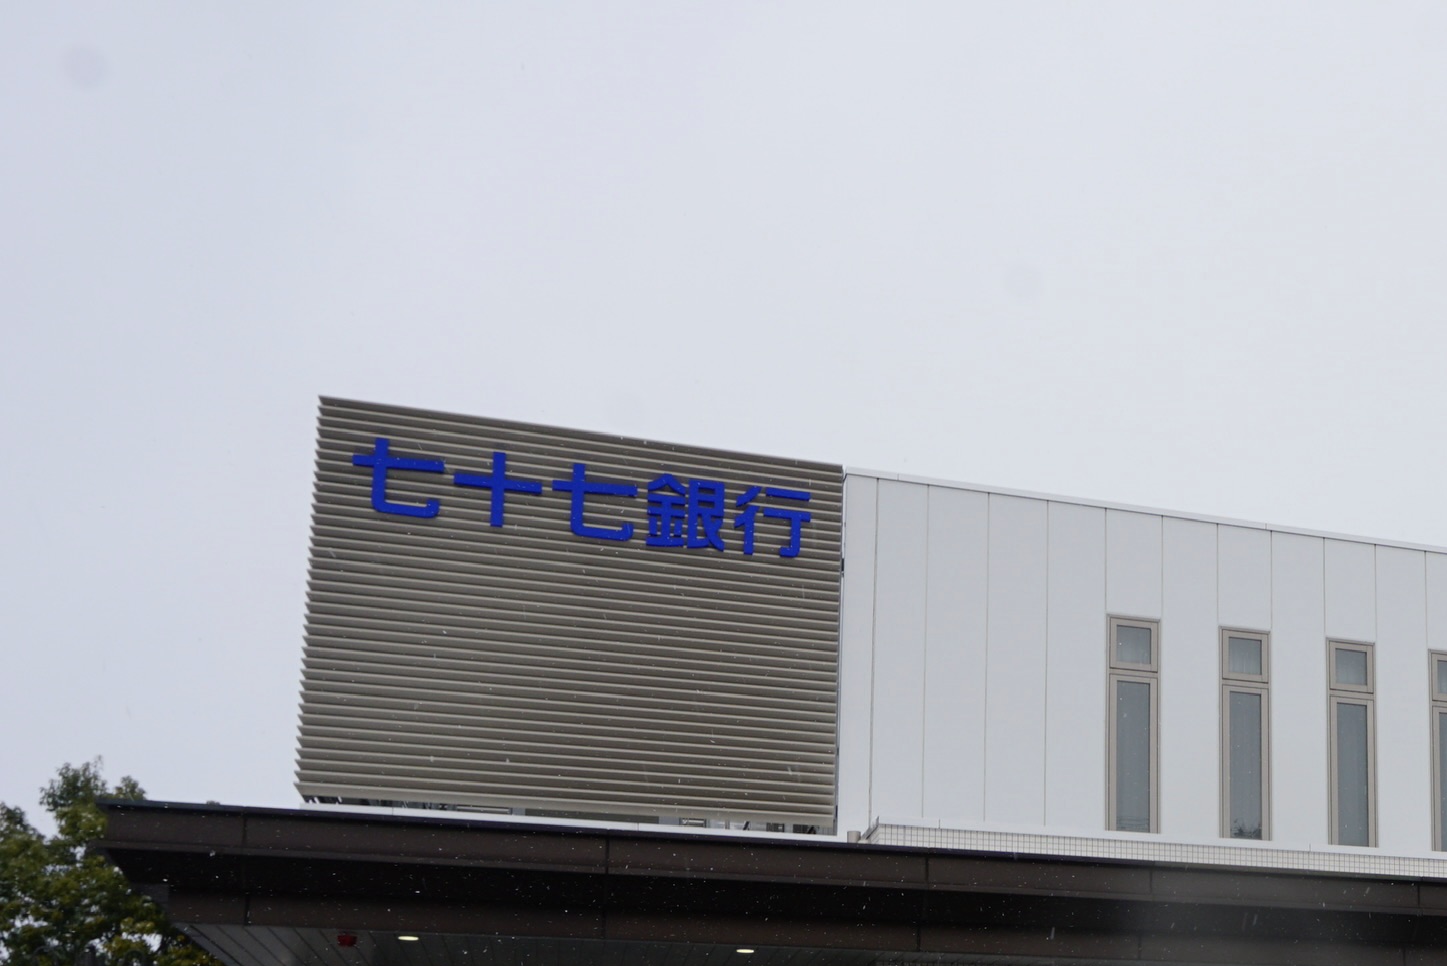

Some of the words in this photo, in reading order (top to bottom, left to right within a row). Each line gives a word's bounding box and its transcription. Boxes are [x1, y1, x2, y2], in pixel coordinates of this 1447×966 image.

[352, 438, 812, 557] 七十七銀行
